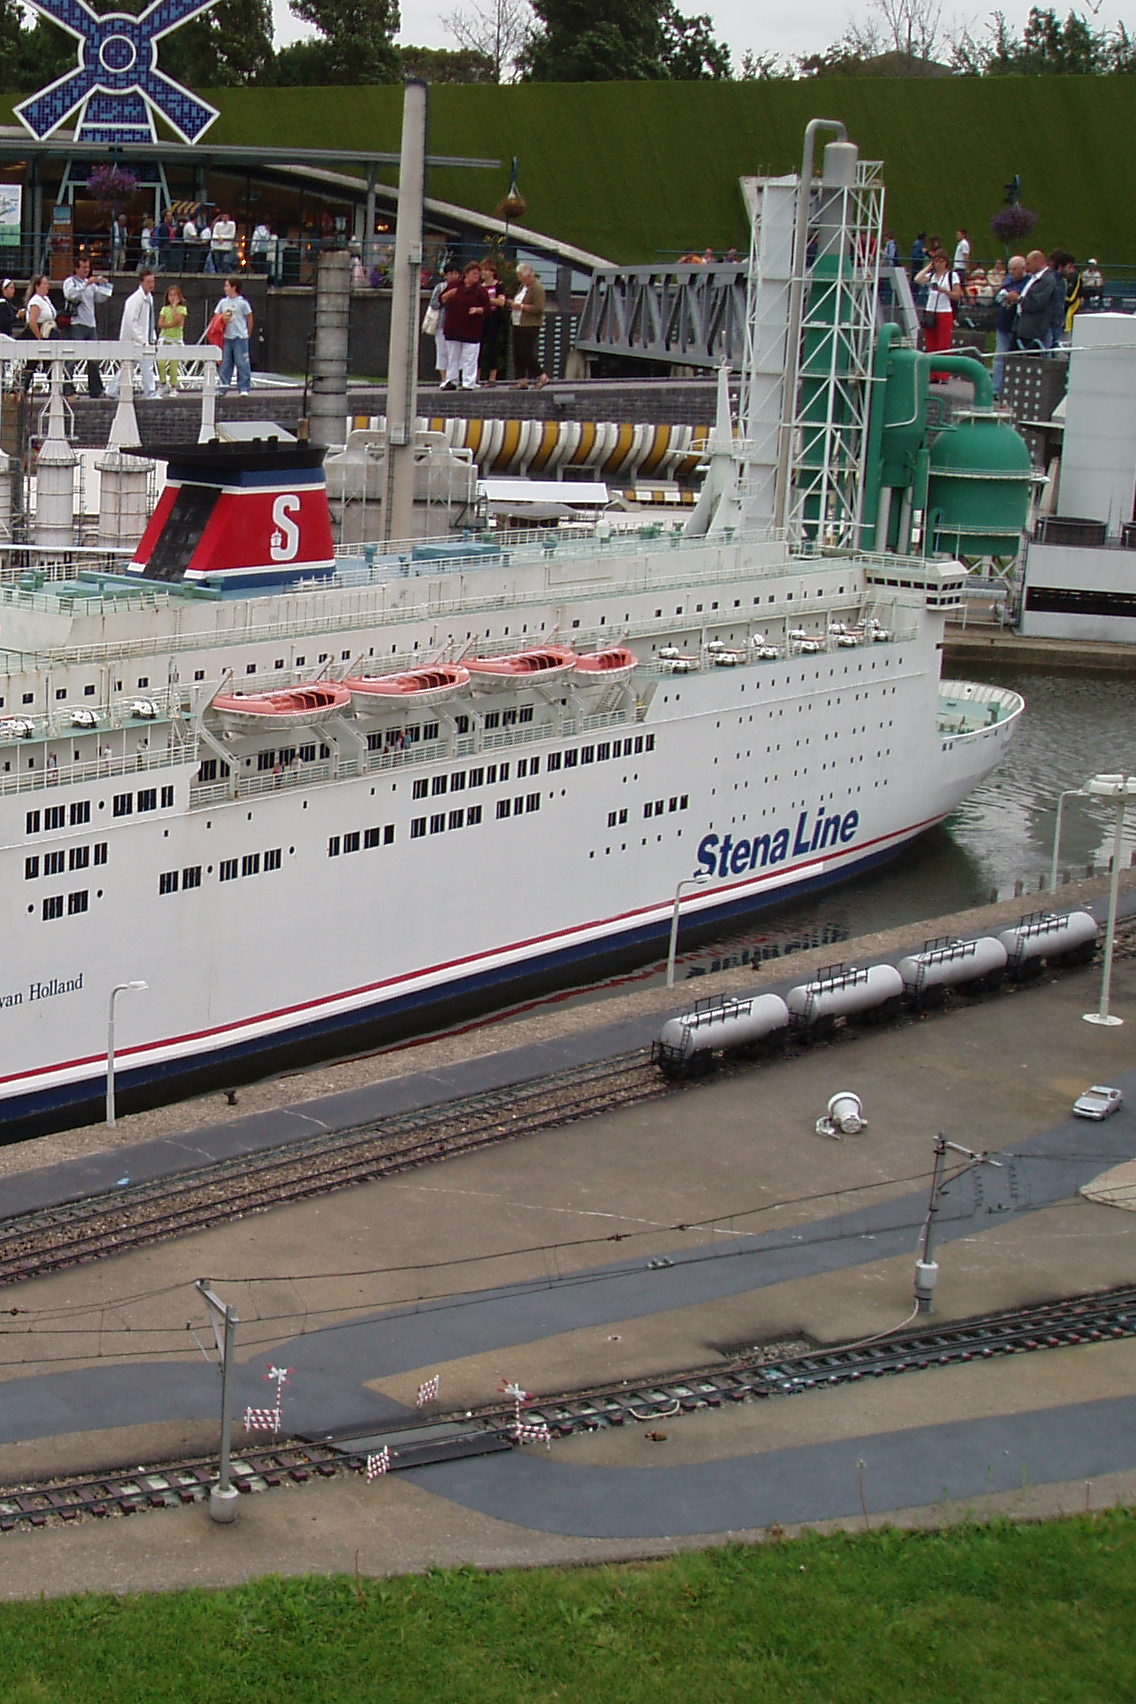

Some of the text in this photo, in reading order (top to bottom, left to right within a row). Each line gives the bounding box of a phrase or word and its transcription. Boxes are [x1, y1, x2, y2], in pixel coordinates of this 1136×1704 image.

[270, 494, 301, 562] S
[693, 806, 860, 878] Stena Line
[28, 972, 84, 1002] Holland
